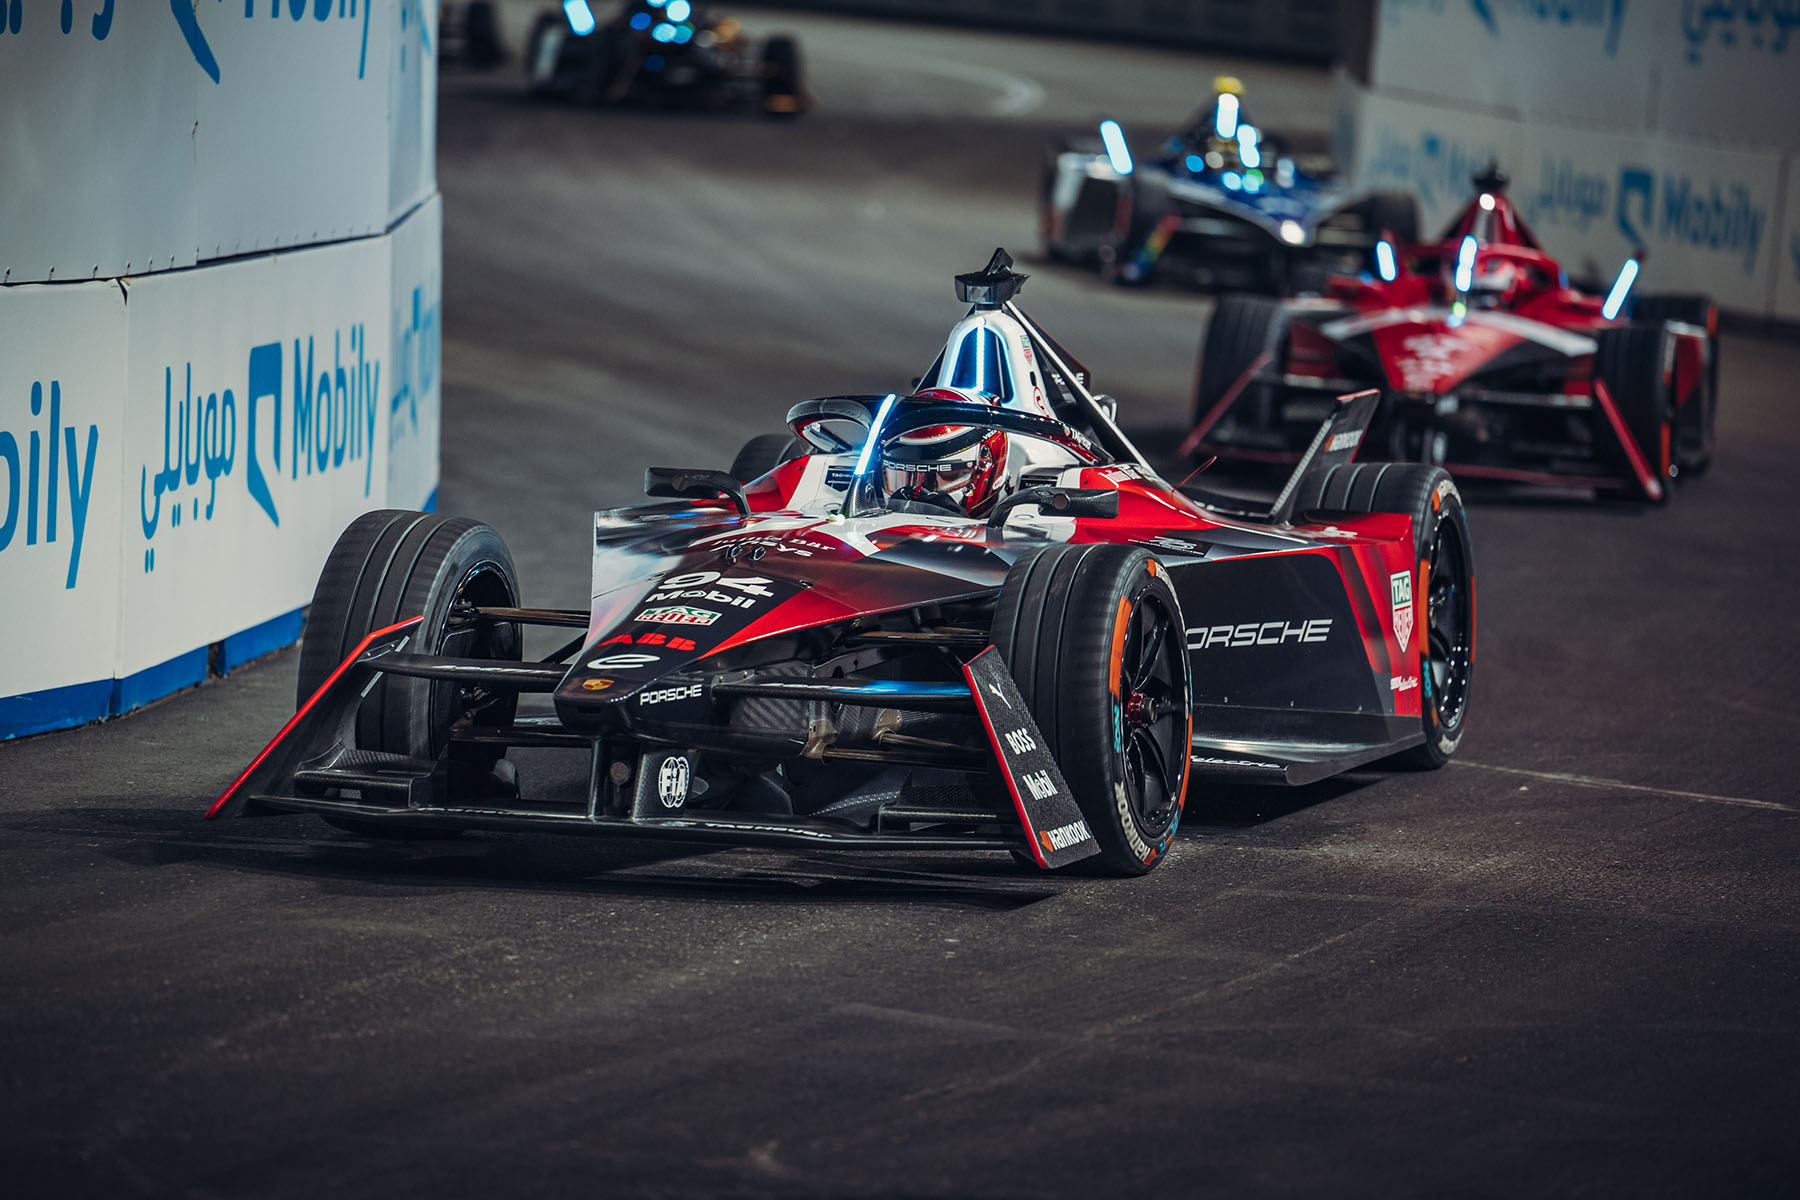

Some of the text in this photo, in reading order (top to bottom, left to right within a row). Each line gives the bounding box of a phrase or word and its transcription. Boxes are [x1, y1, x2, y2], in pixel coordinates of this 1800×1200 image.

[293, 323, 380, 498] Mobily
[141, 362, 237, 574] موبايلي
[658, 571, 775, 598] 94
[1393, 577, 1411, 604] TAG
[645, 590, 757, 609] Mobil
[597, 633, 697, 652] ABB
[1186, 619, 1333, 650] ORSCHE
[640, 684, 703, 706] PORSCHE
[1005, 728, 1037, 755] BOSS
[1022, 769, 1059, 801] Mobil
